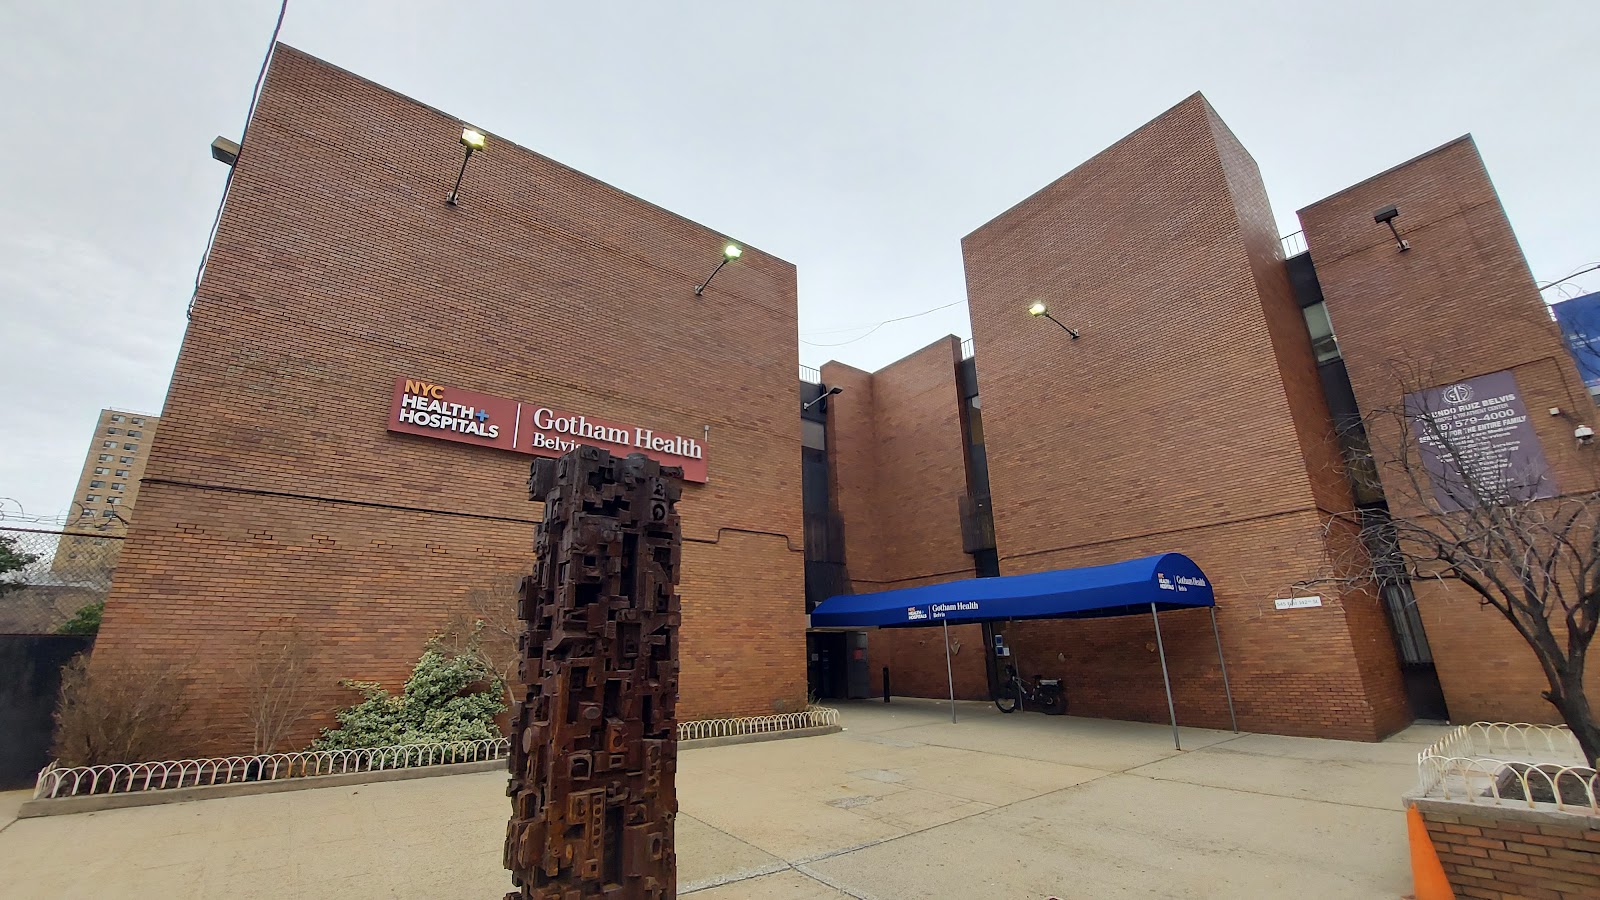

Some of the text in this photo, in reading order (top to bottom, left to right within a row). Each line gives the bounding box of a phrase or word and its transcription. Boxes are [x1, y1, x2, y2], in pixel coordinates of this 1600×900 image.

[404, 380, 445, 400] NYC
[1458, 401, 1481, 413] RUIZ
[1481, 393, 1516, 407] BELVIS
[399, 408, 499, 438] HOSPITALS
[1455, 408, 1515, 428] 579-4000
[1463, 425, 1477, 434] THE
[1477, 420, 1503, 432] ENTIRE
[1502, 415, 1527, 426] FAMILY
[533, 407, 702, 459] Gotham Health
[932, 601, 979, 612] Gotham Health
